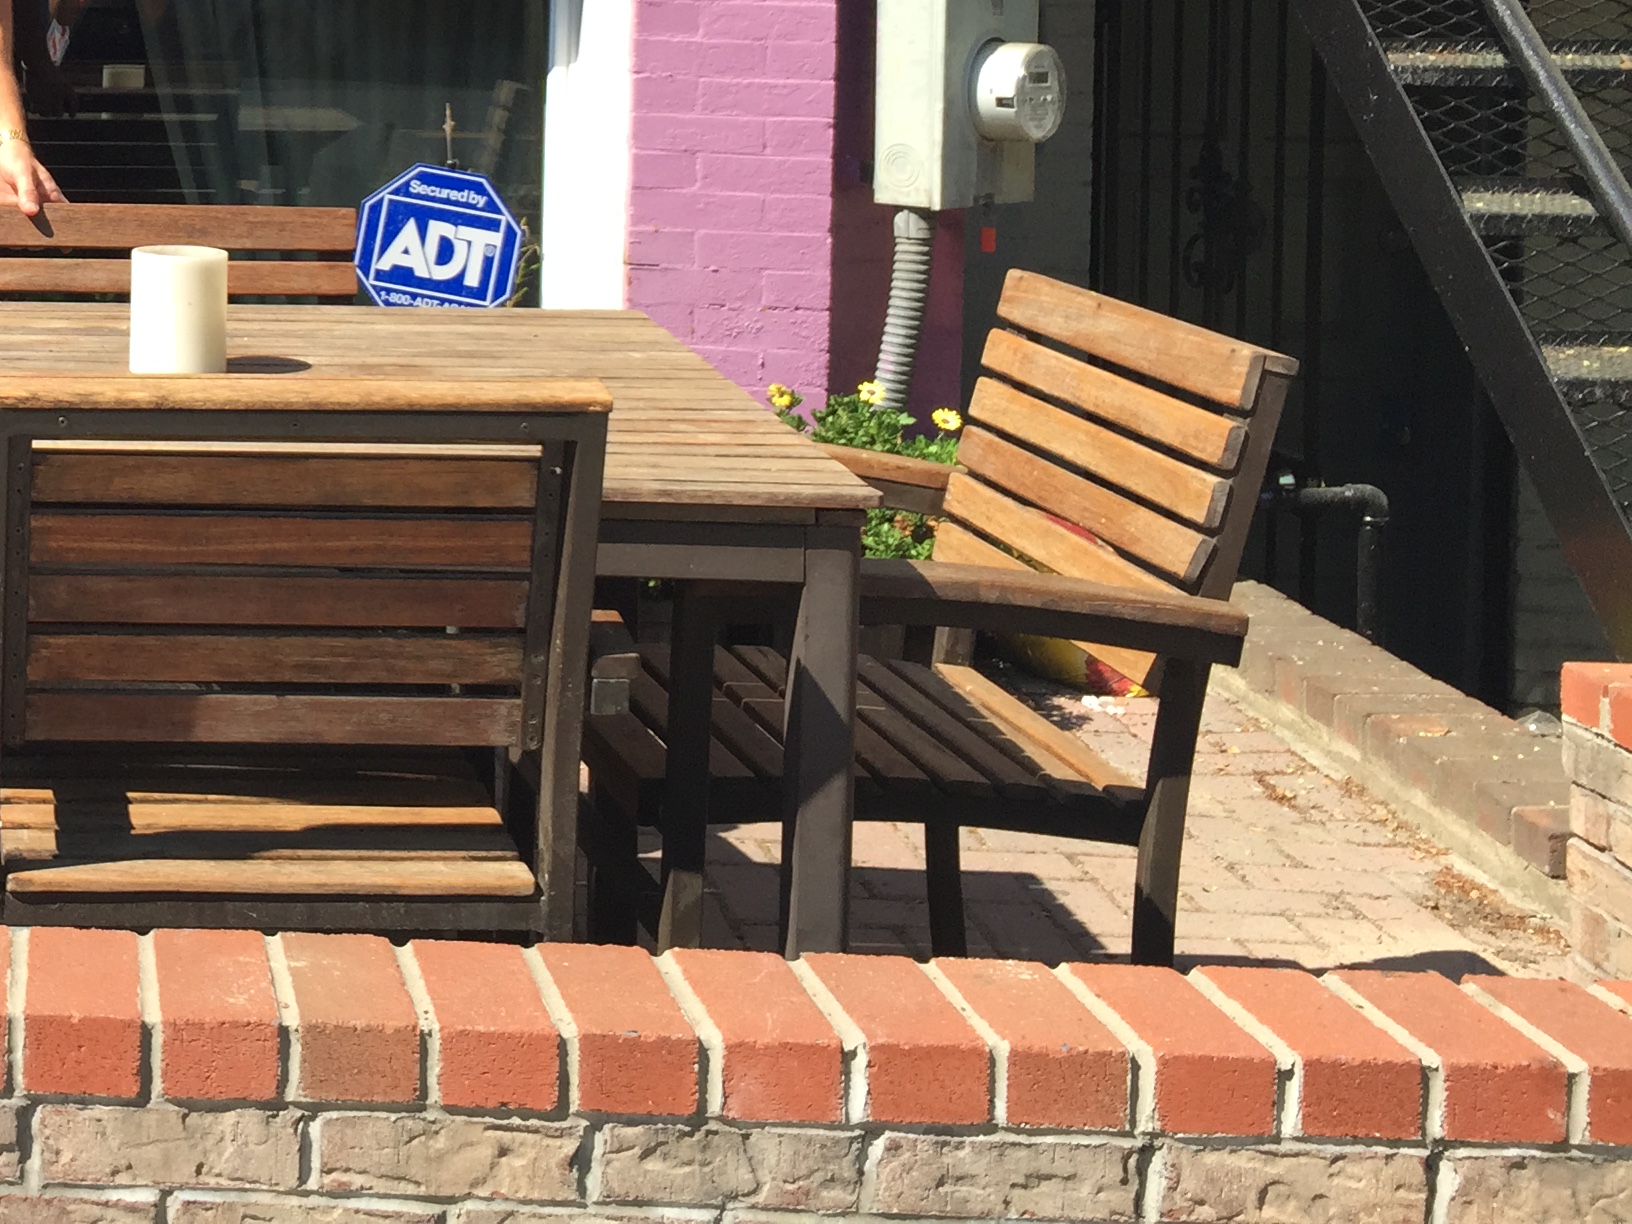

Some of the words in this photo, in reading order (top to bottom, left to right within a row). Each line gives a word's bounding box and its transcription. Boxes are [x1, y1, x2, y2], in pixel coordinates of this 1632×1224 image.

[409, 179, 468, 203] Secured
[469, 190, 487, 208] by
[375, 217, 501, 288] ADT
